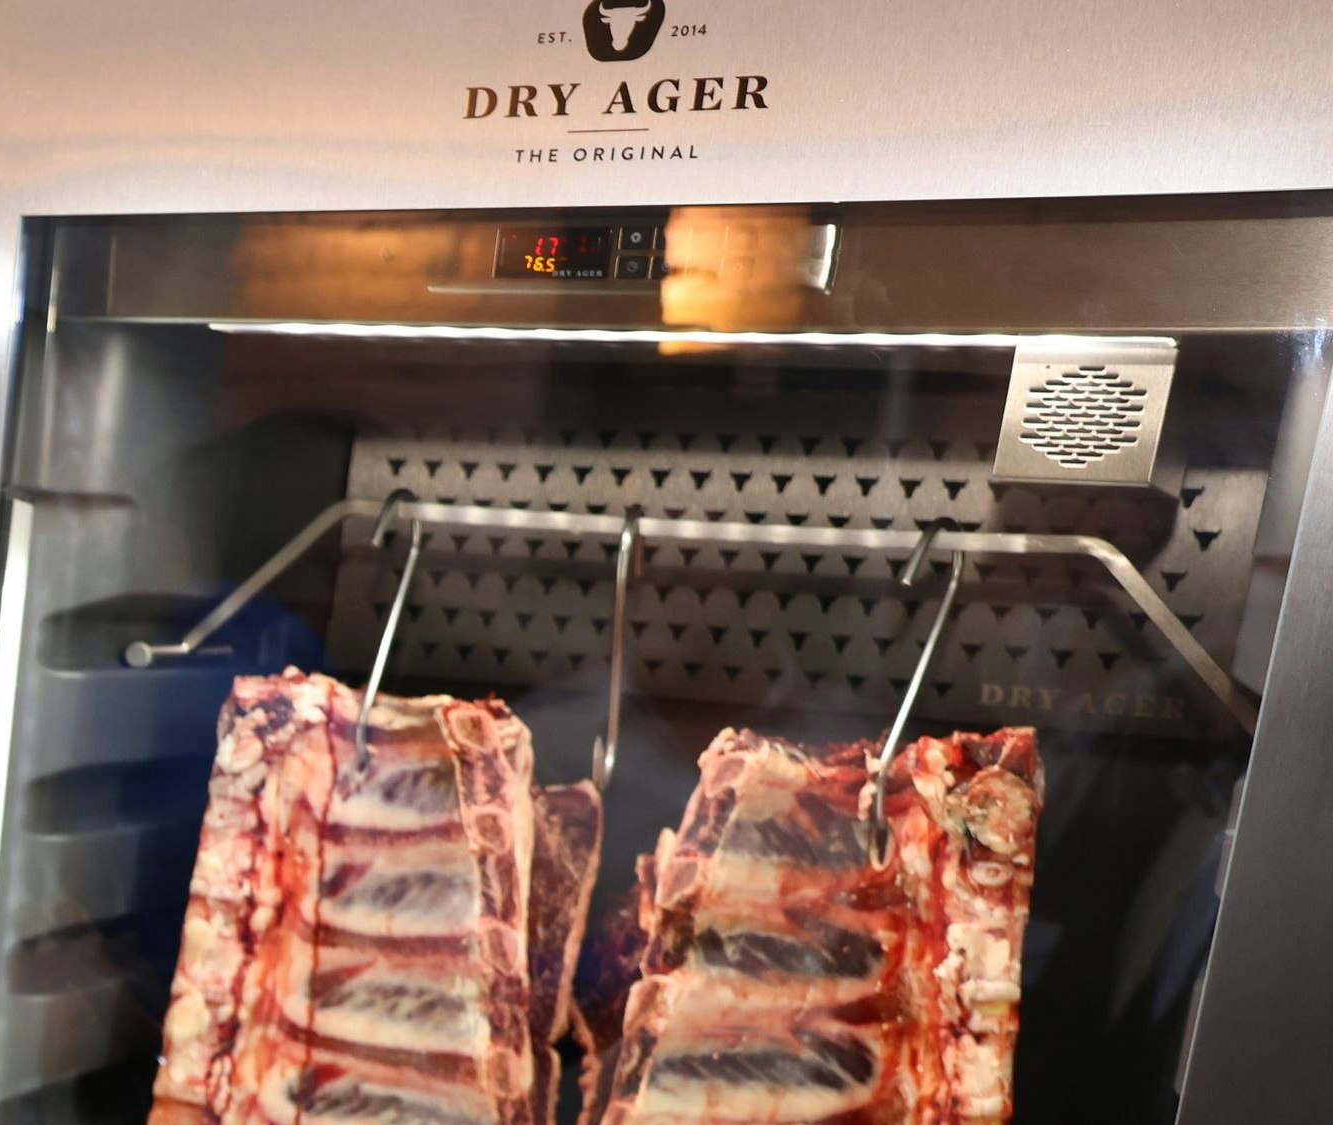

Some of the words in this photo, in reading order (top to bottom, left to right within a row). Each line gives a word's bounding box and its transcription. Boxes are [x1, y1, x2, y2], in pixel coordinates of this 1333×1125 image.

[537, 31, 573, 44] EST.
[671, 24, 708, 37] 2014
[462, 82, 581, 120] DRY
[602, 75, 770, 115] AGER
[516, 148, 559, 163] THE
[573, 145, 699, 162] ORIGINAL
[980, 683, 1061, 710] DRY
[1083, 690, 1186, 719] AGER
